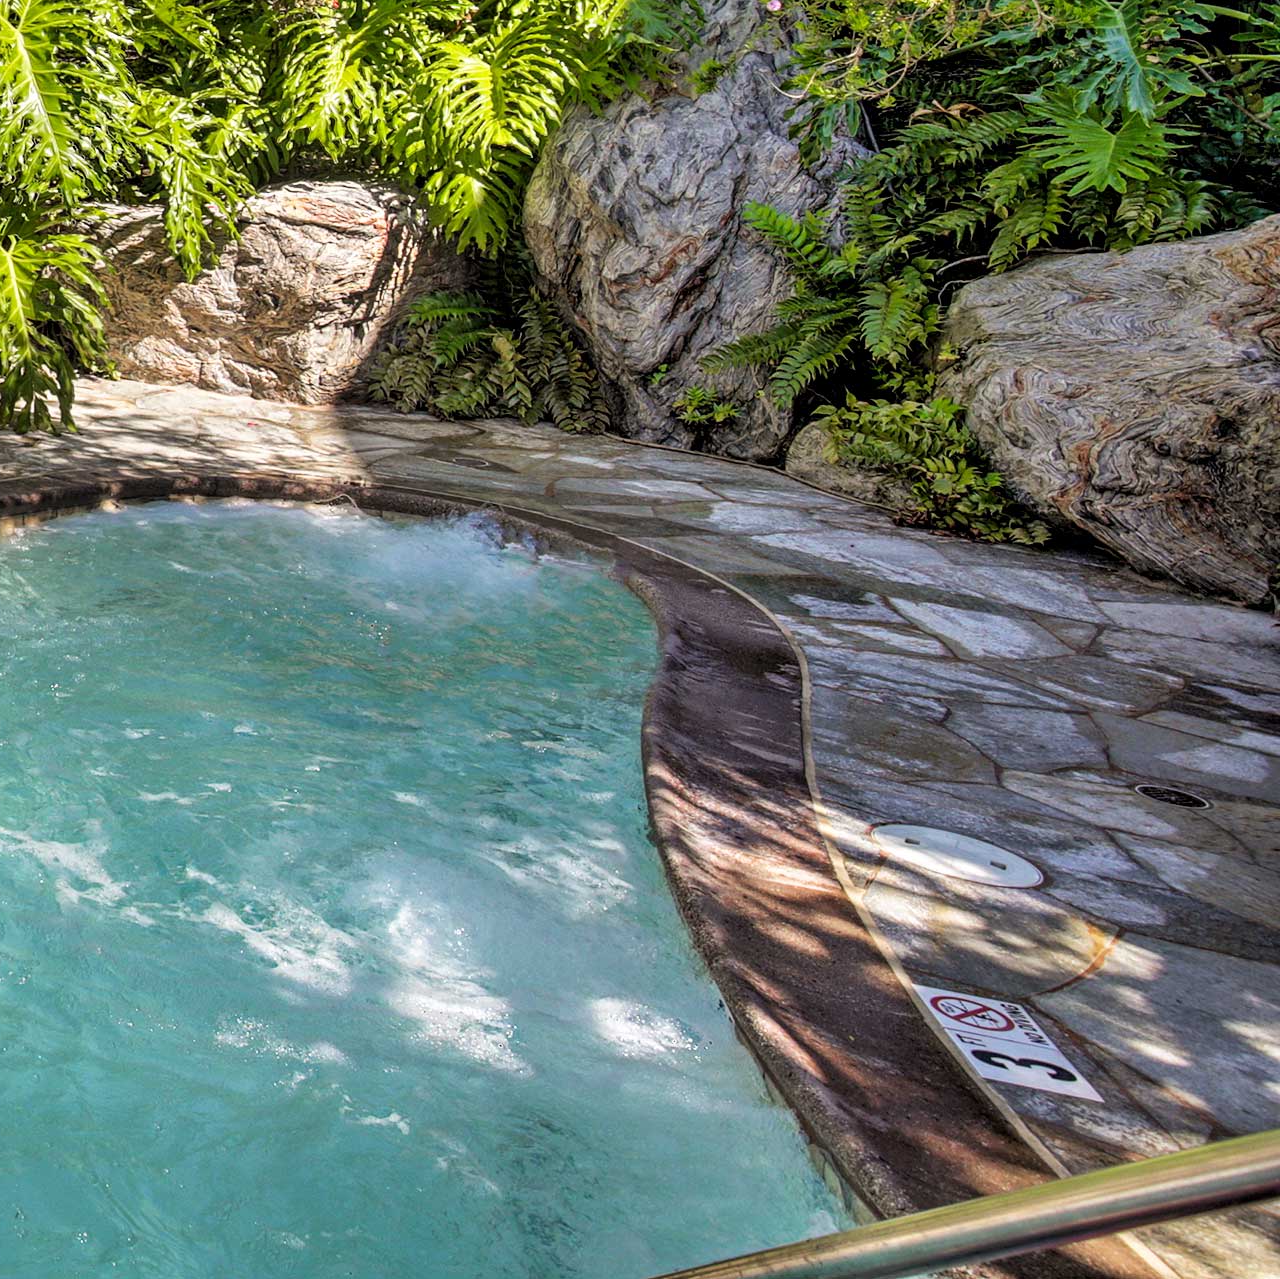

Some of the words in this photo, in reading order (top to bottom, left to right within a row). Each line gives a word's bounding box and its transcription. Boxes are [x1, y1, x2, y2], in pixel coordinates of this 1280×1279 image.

[956, 1033, 987, 1048] FT
[1024, 1031, 1049, 1046] NO
[971, 1049, 1078, 1082] 3
